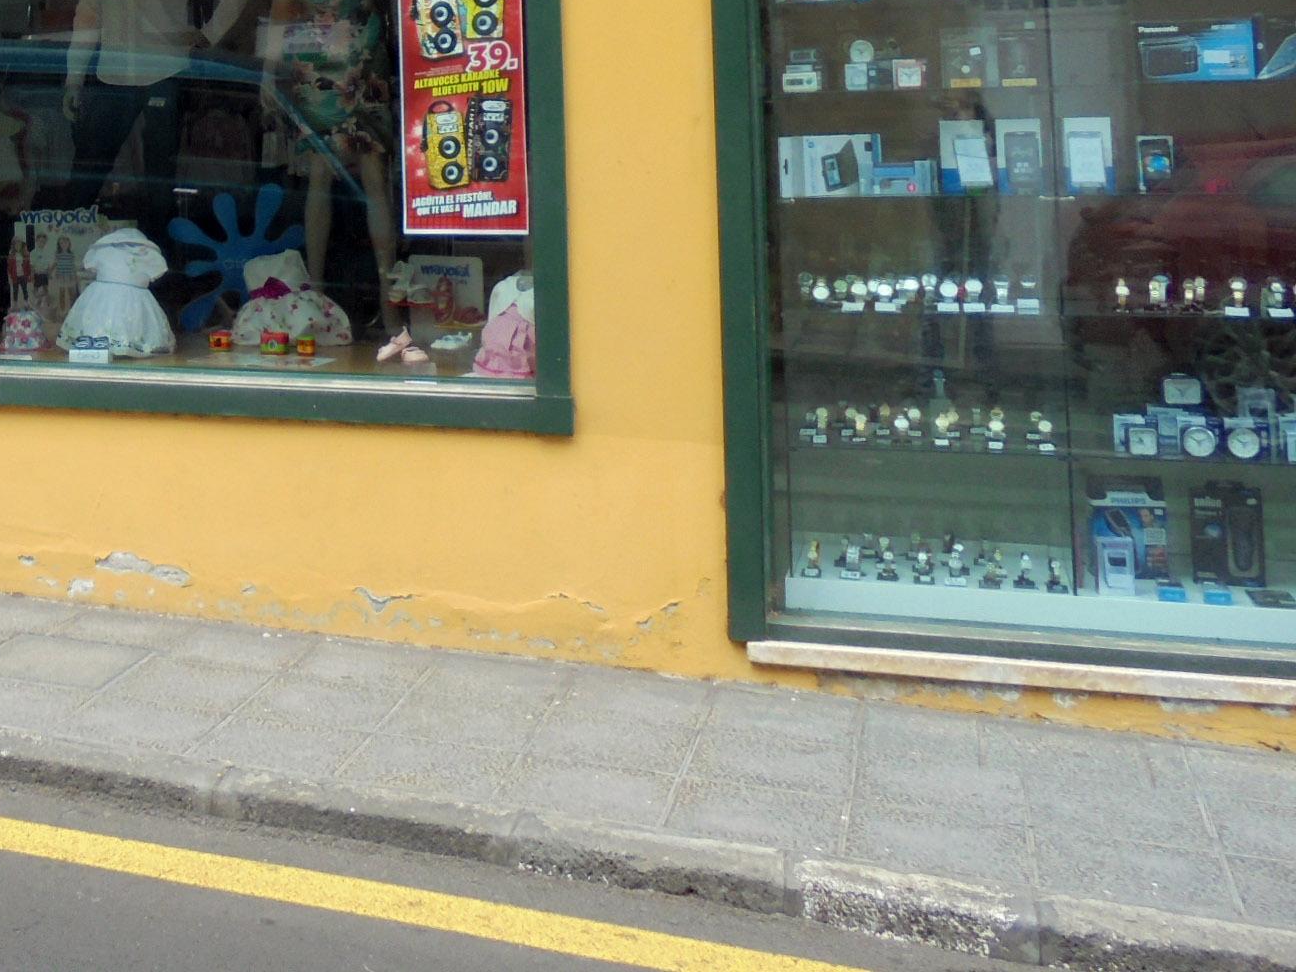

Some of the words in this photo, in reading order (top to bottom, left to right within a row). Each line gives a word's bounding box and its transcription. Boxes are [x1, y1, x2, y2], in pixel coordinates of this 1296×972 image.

[414, 74, 460, 89] ALTAVOCES
[461, 69, 500, 83] KARAOKE
[432, 82, 480, 97] BLUETOOTH
[481, 78, 509, 94] 10W
[446, 194, 455, 204] EL
[463, 199, 517, 218] MANDAR
[20, 205, 98, 227] mayoral
[432, 205, 440, 214] TE
[454, 204, 461, 212] A
